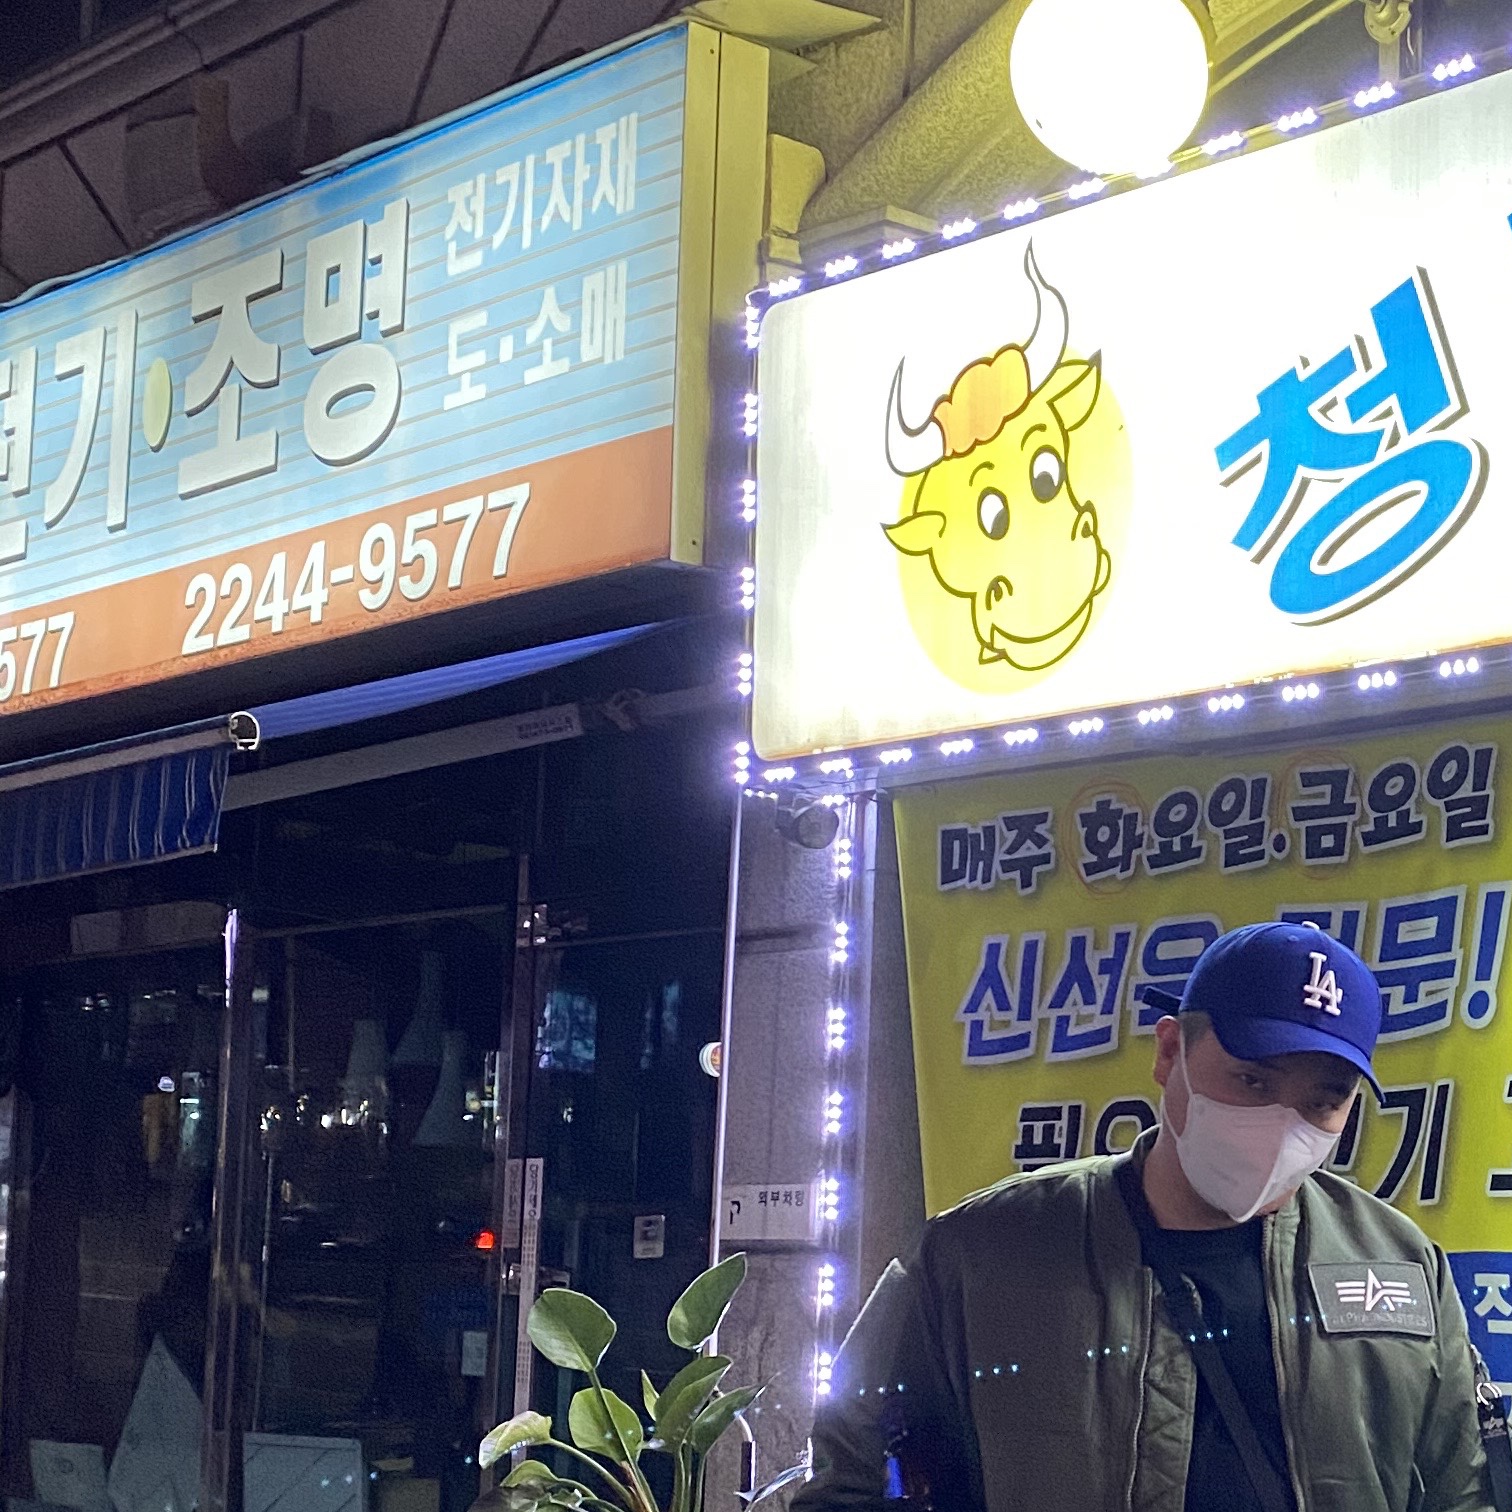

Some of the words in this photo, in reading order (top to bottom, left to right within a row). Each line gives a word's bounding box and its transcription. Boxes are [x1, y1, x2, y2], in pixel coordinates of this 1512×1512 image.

[444, 113, 638, 276] 전기자재
[443, 260, 628, 411] 도·소매
[182, 483, 531, 656] 2244-9577
[940, 811, 1052, 889] 매주
[1304, 951, 1343, 1017] LA
